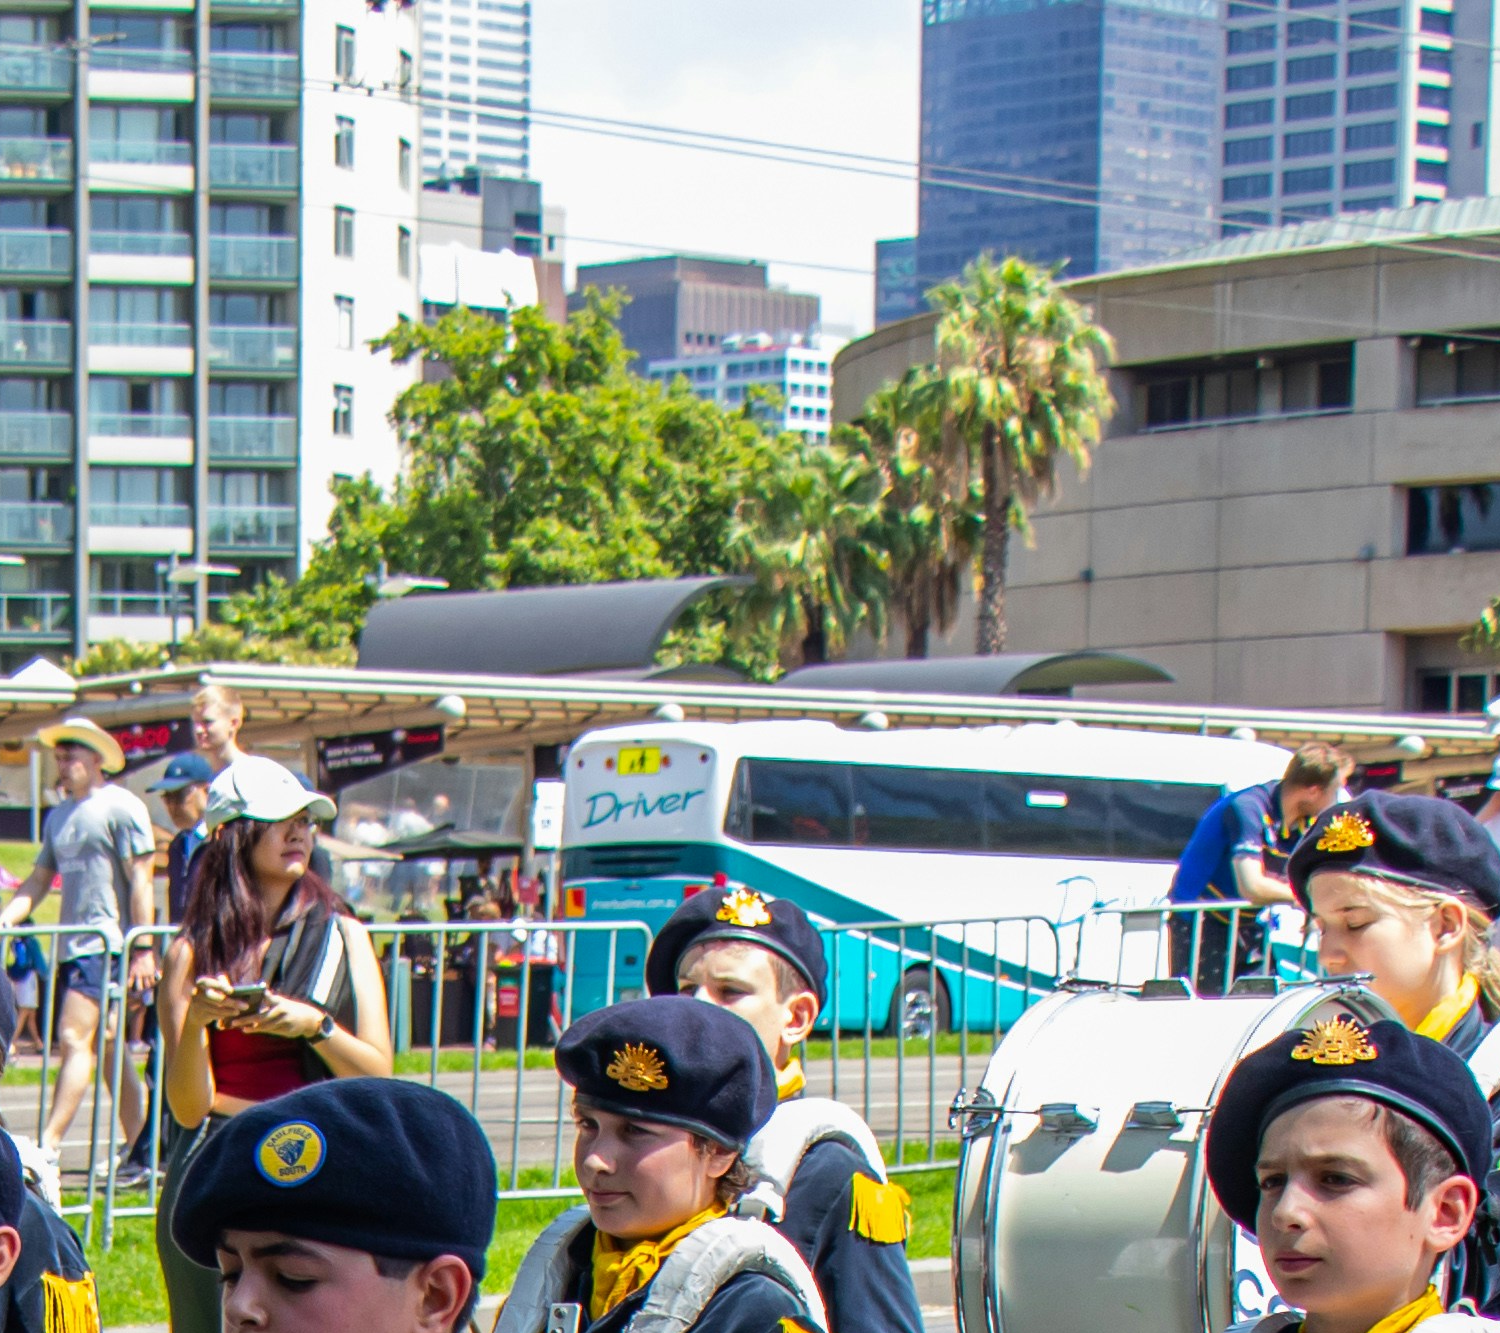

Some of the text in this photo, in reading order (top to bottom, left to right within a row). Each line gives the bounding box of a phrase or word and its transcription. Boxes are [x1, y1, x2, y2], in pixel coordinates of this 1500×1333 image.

[582, 789, 706, 829] Driver
[266, 1127, 312, 1148] CAULFIELD
[279, 1164, 308, 1177] SOUTH
